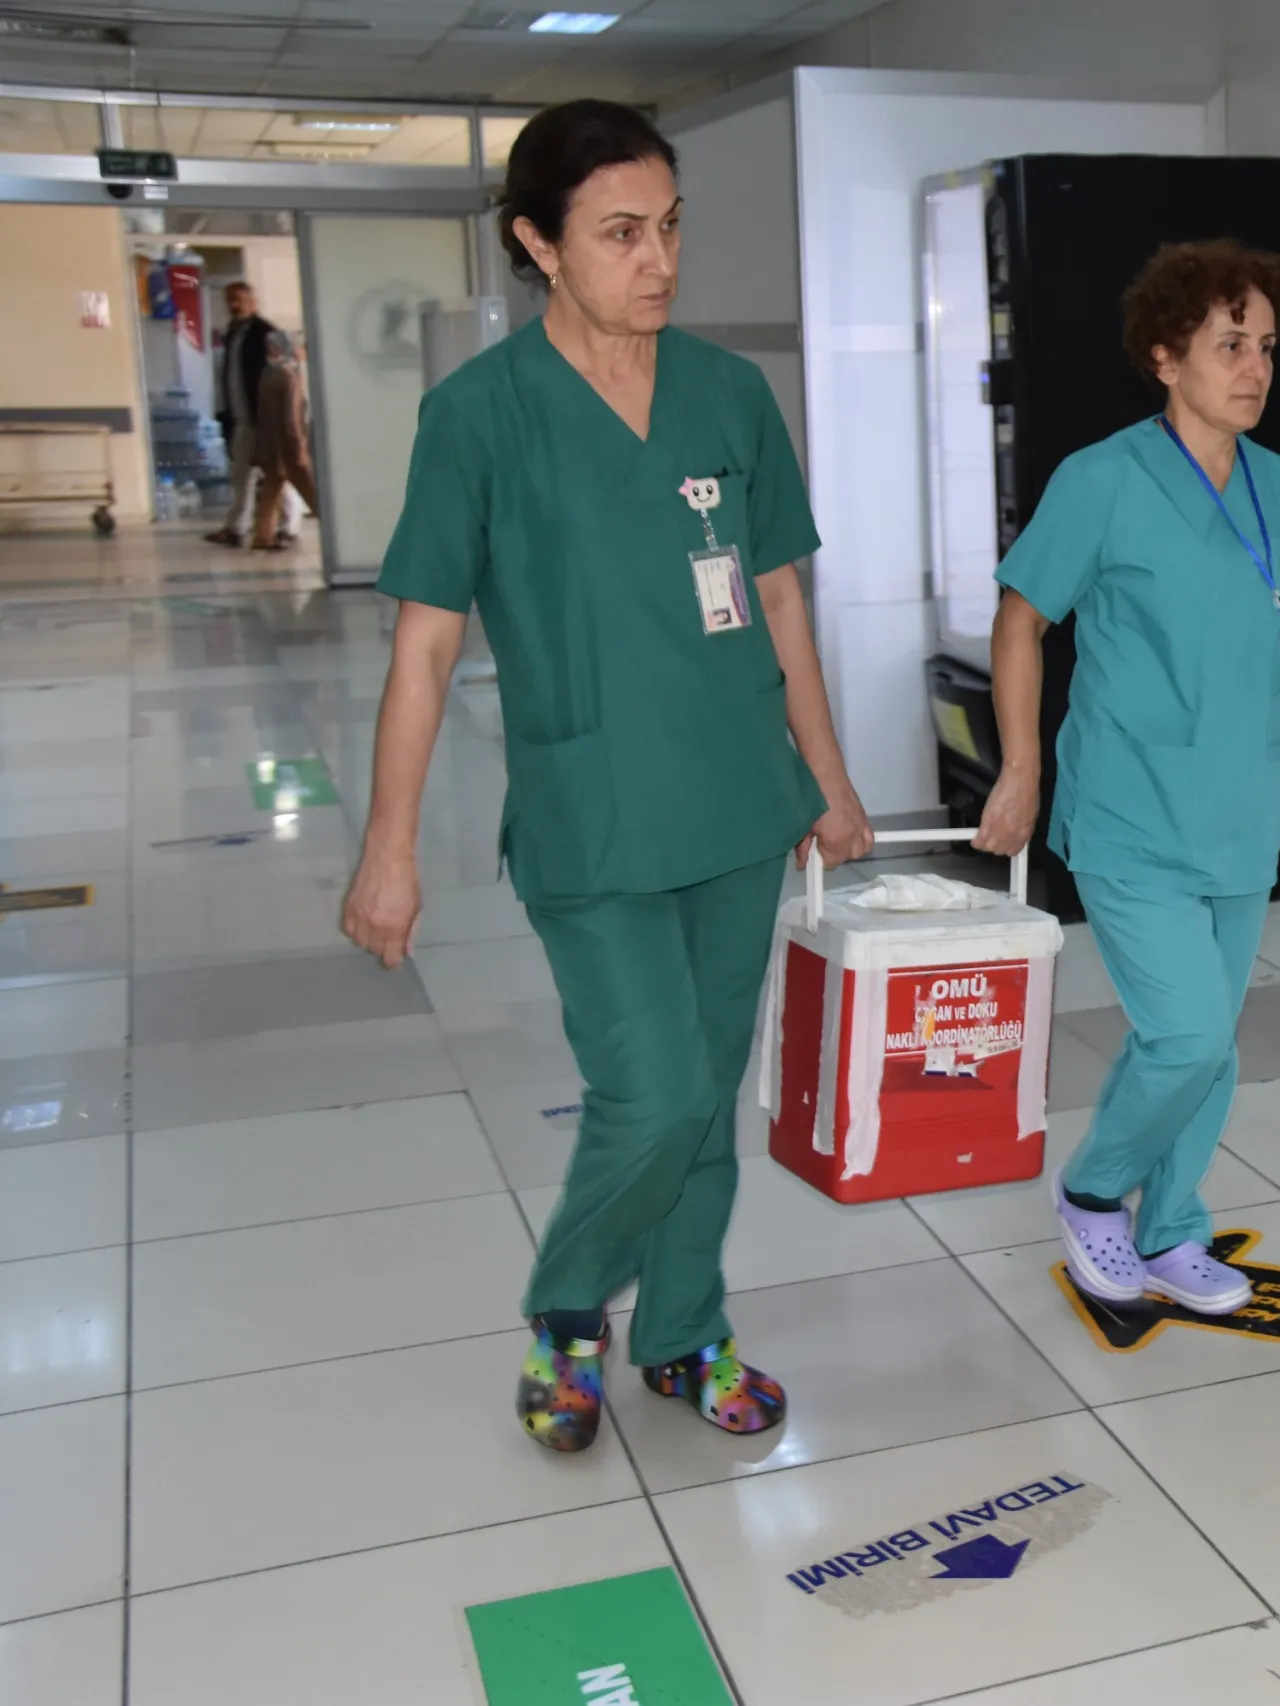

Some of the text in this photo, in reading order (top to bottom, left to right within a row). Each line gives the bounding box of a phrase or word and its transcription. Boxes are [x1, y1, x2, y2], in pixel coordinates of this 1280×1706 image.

[932, 973, 987, 999] OMÜ
[954, 1007, 965, 1020] VE
[968, 1002, 998, 1019] DOKU
[786, 1475, 1086, 1595] TEDAVİ BİRİMİ
